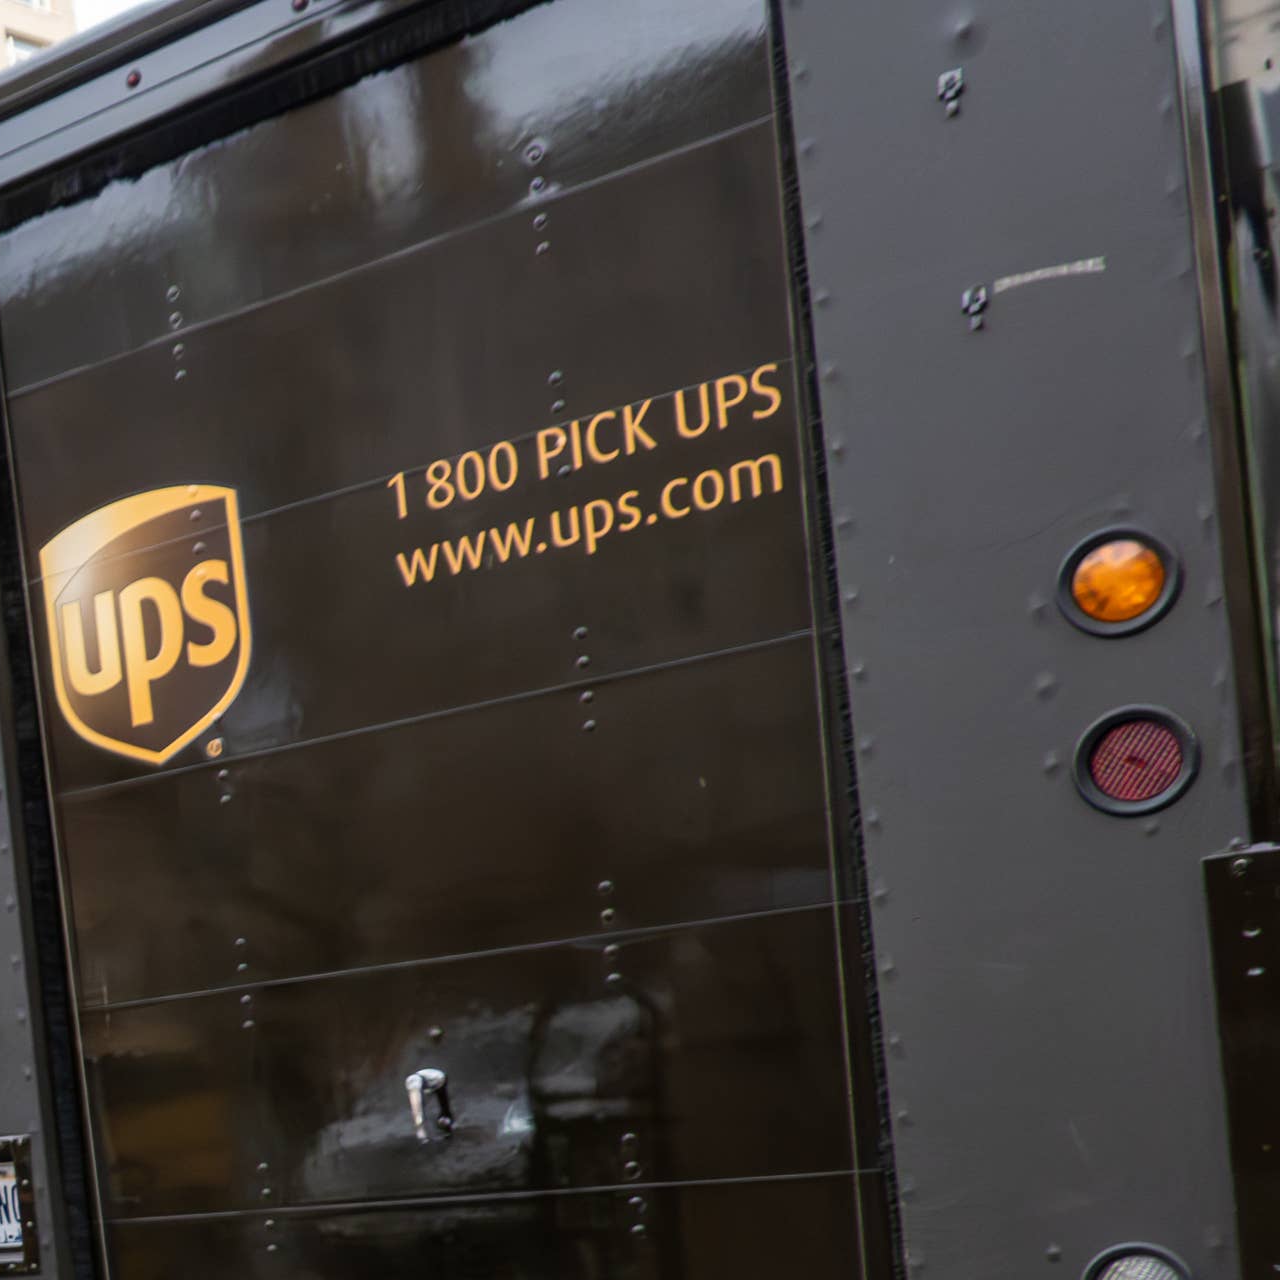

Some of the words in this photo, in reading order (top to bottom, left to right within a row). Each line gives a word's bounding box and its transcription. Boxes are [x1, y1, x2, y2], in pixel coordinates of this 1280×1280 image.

[386, 471, 408, 518] 1
[425, 441, 519, 509] 800
[536, 399, 657, 481] PICK
[674, 364, 782, 440] UPS
[395, 453, 784, 588] www.ups.com
[61, 559, 236, 728] ups
